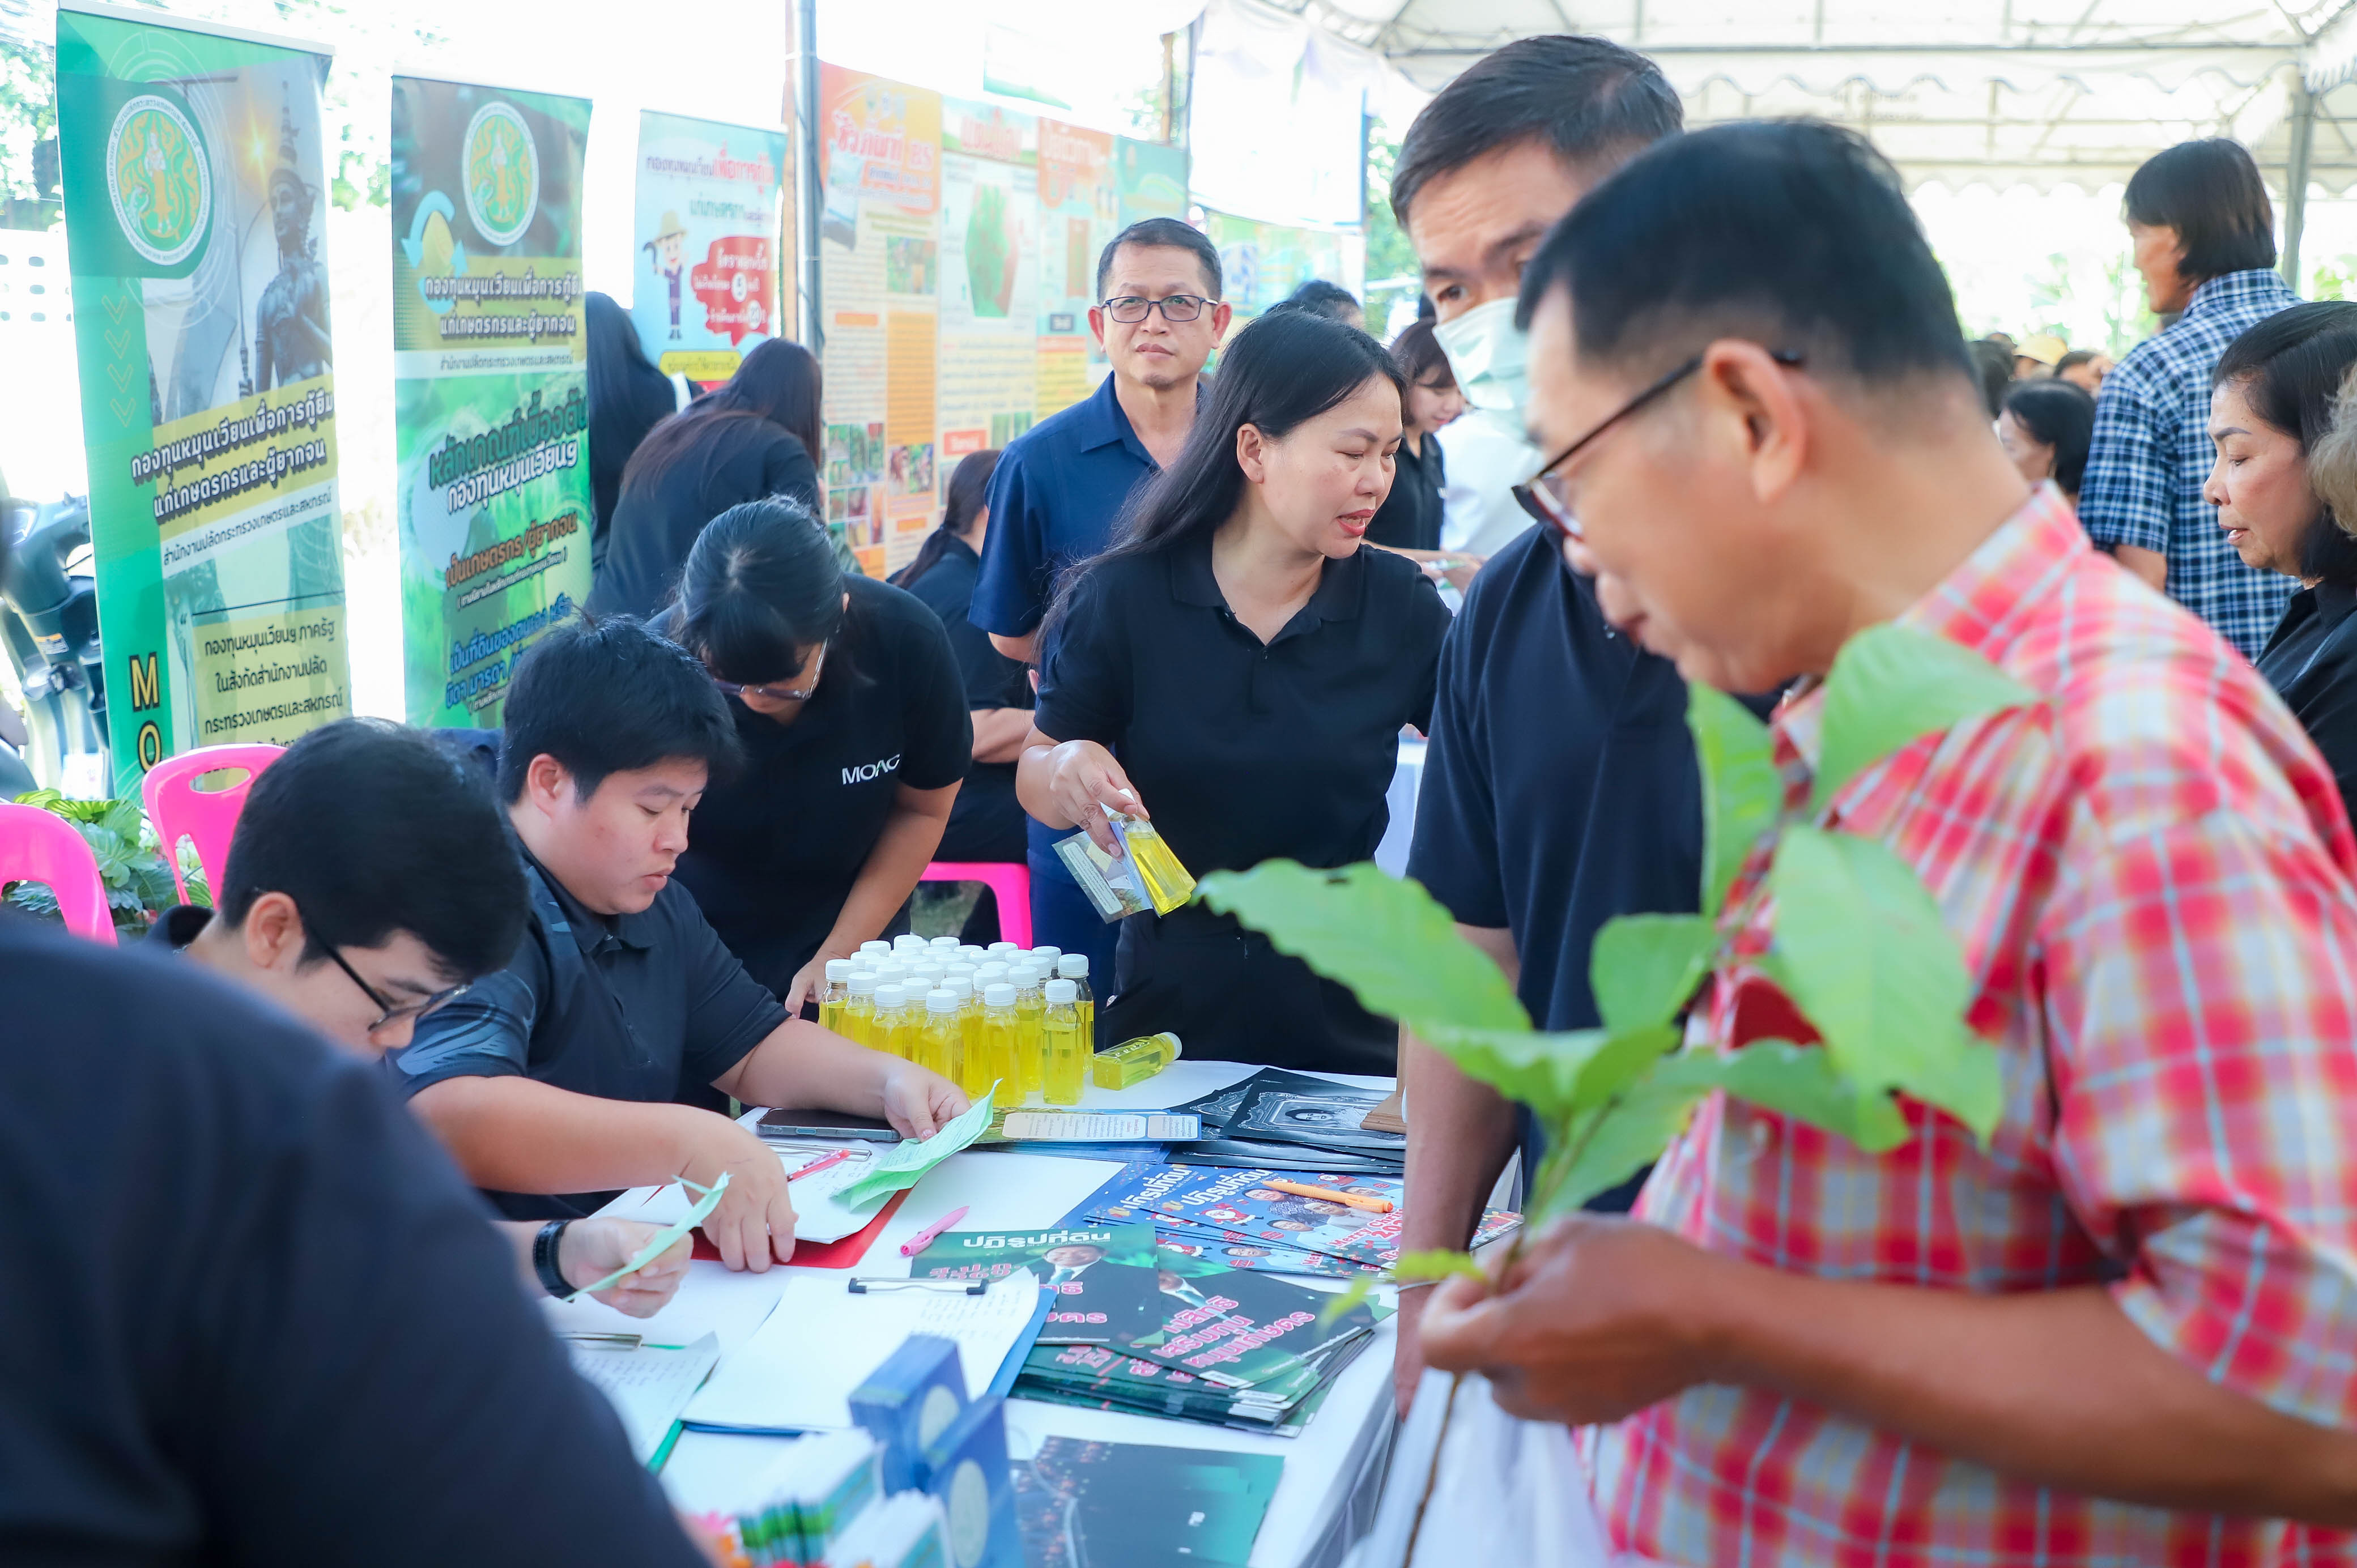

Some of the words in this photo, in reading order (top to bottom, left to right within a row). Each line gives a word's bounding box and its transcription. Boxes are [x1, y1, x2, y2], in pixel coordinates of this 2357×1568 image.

[131, 387, 334, 480] กองทุนหมุนเวียนเพื่อการกู้ยืม
[154, 438, 327, 519] แก่เกษตรกรและผู้ยากจน
[299, 617, 335, 642] ภาครัฐ
[216, 654, 327, 693] ในสังกัดสำนักงานปลัด
[205, 686, 343, 734] กระทรวงเกษตรและสหกรณ์
[842, 754, 900, 785] MOAC
[1181, 1169, 1274, 1205] ปฏิรูปที่ดิน
[963, 1230, 1111, 1249] ปฏิรูปที่ดิน
[1326, 1228, 1372, 1246] Merry
